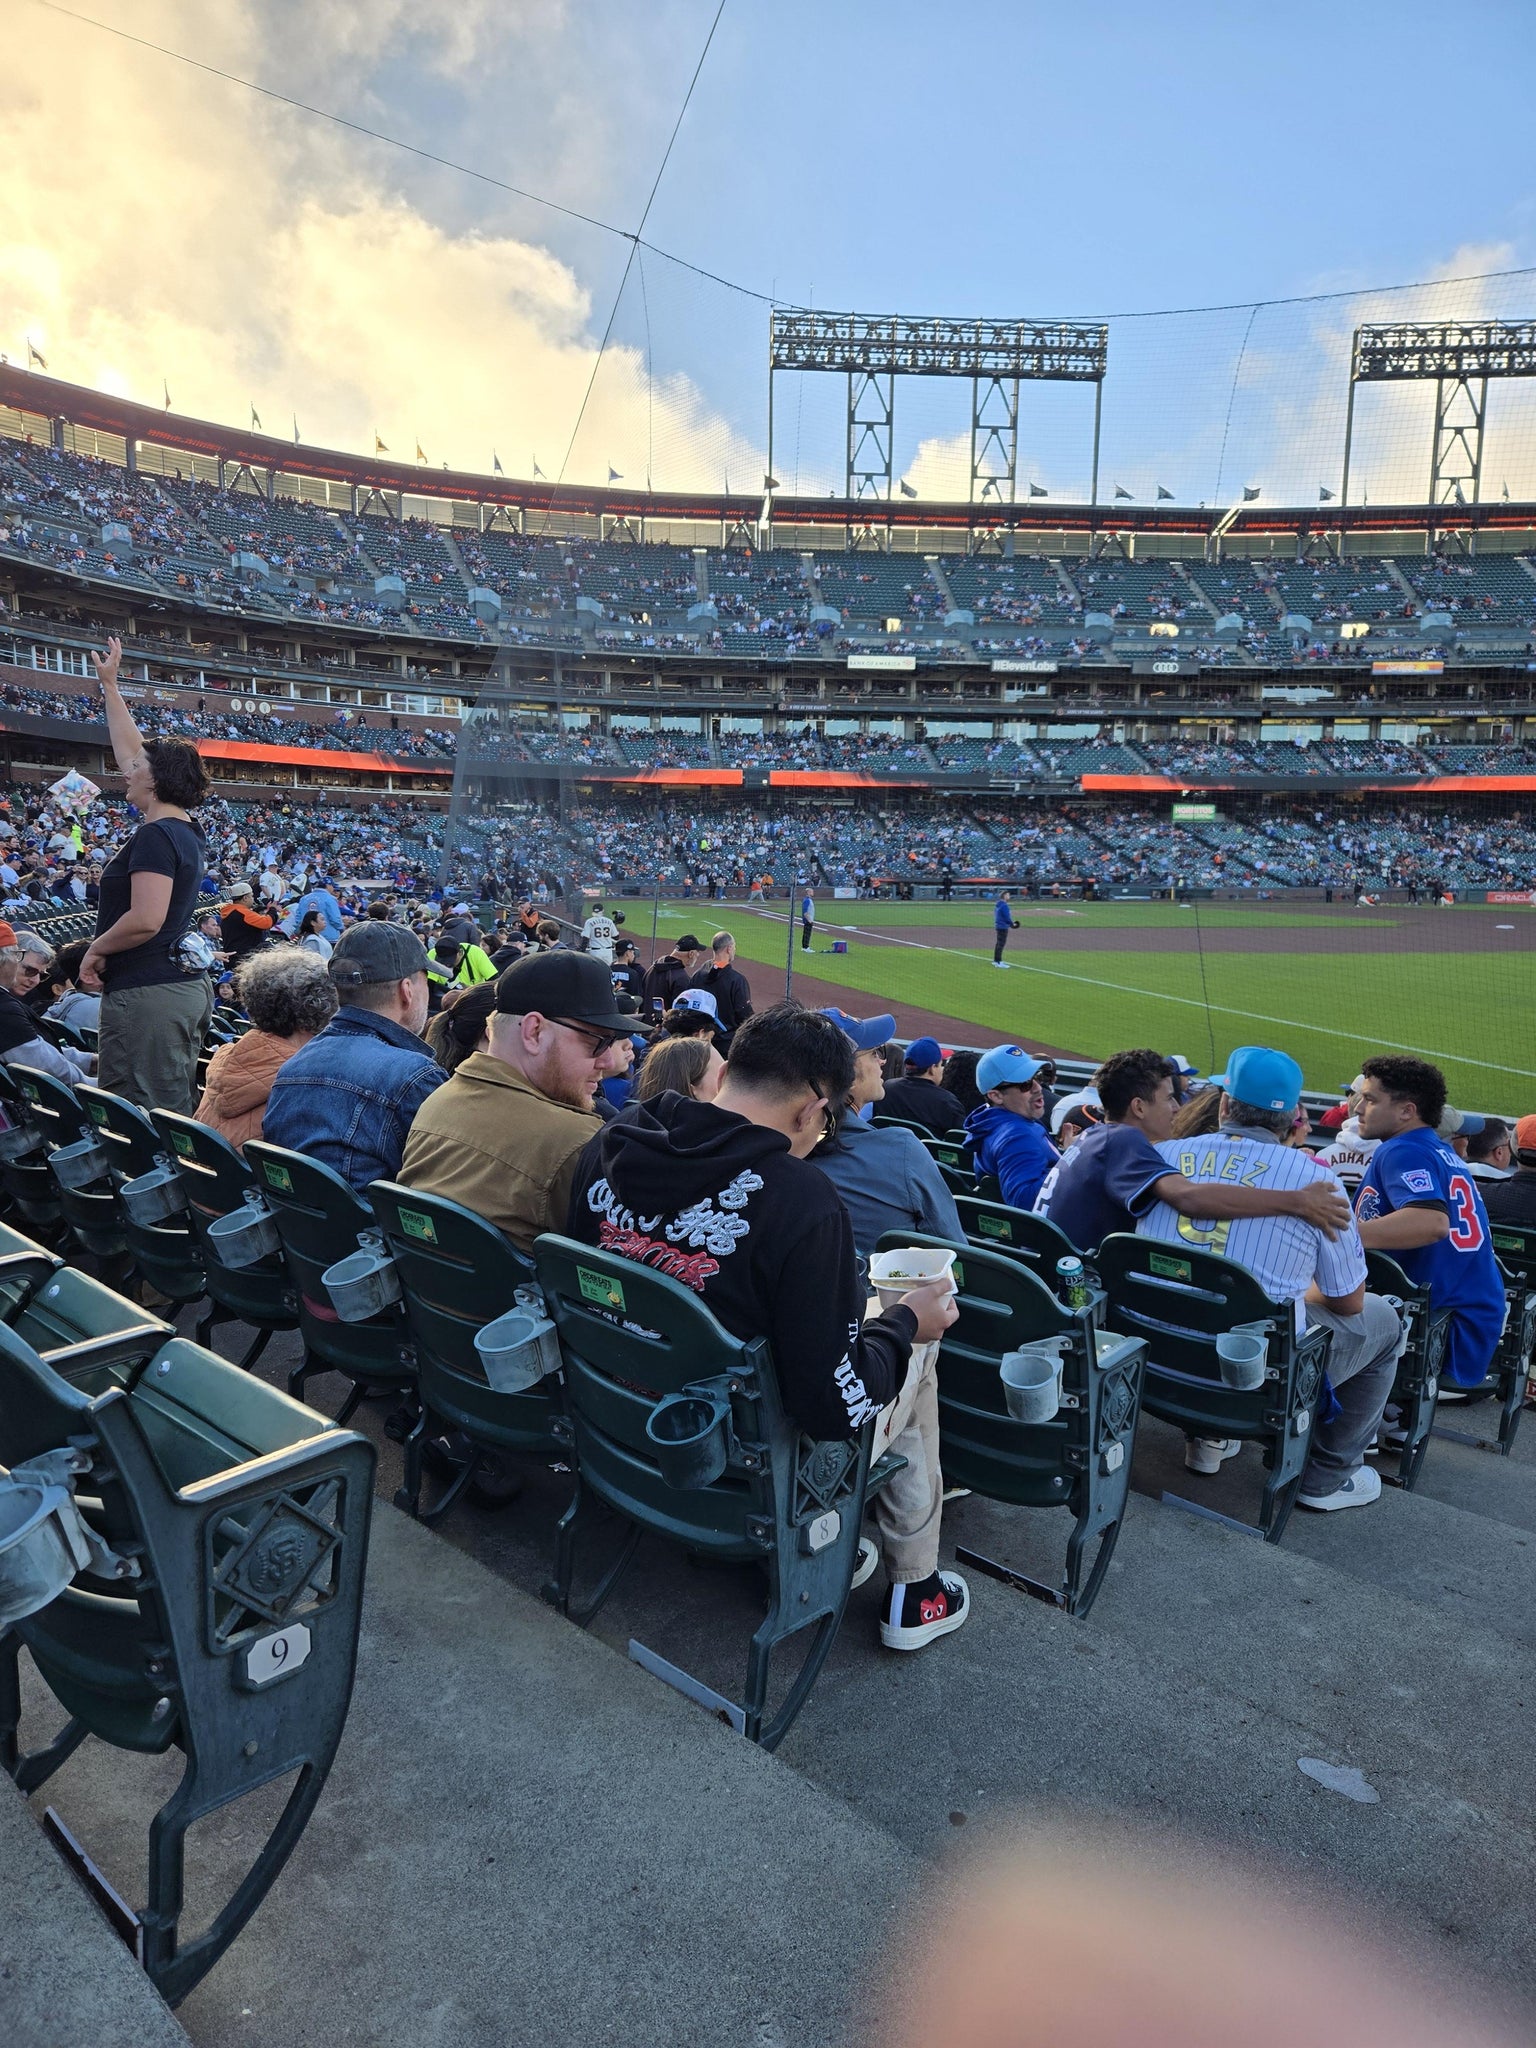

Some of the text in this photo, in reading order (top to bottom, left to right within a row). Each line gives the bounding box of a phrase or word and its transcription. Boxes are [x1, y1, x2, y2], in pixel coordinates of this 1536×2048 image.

[594, 926, 611, 938] 63
[1179, 1151, 1271, 1189] BAEZ
[1112, 1448, 1118, 1465] 7
[820, 1518, 829, 1540] 8
[271, 1637, 289, 1671] 9
